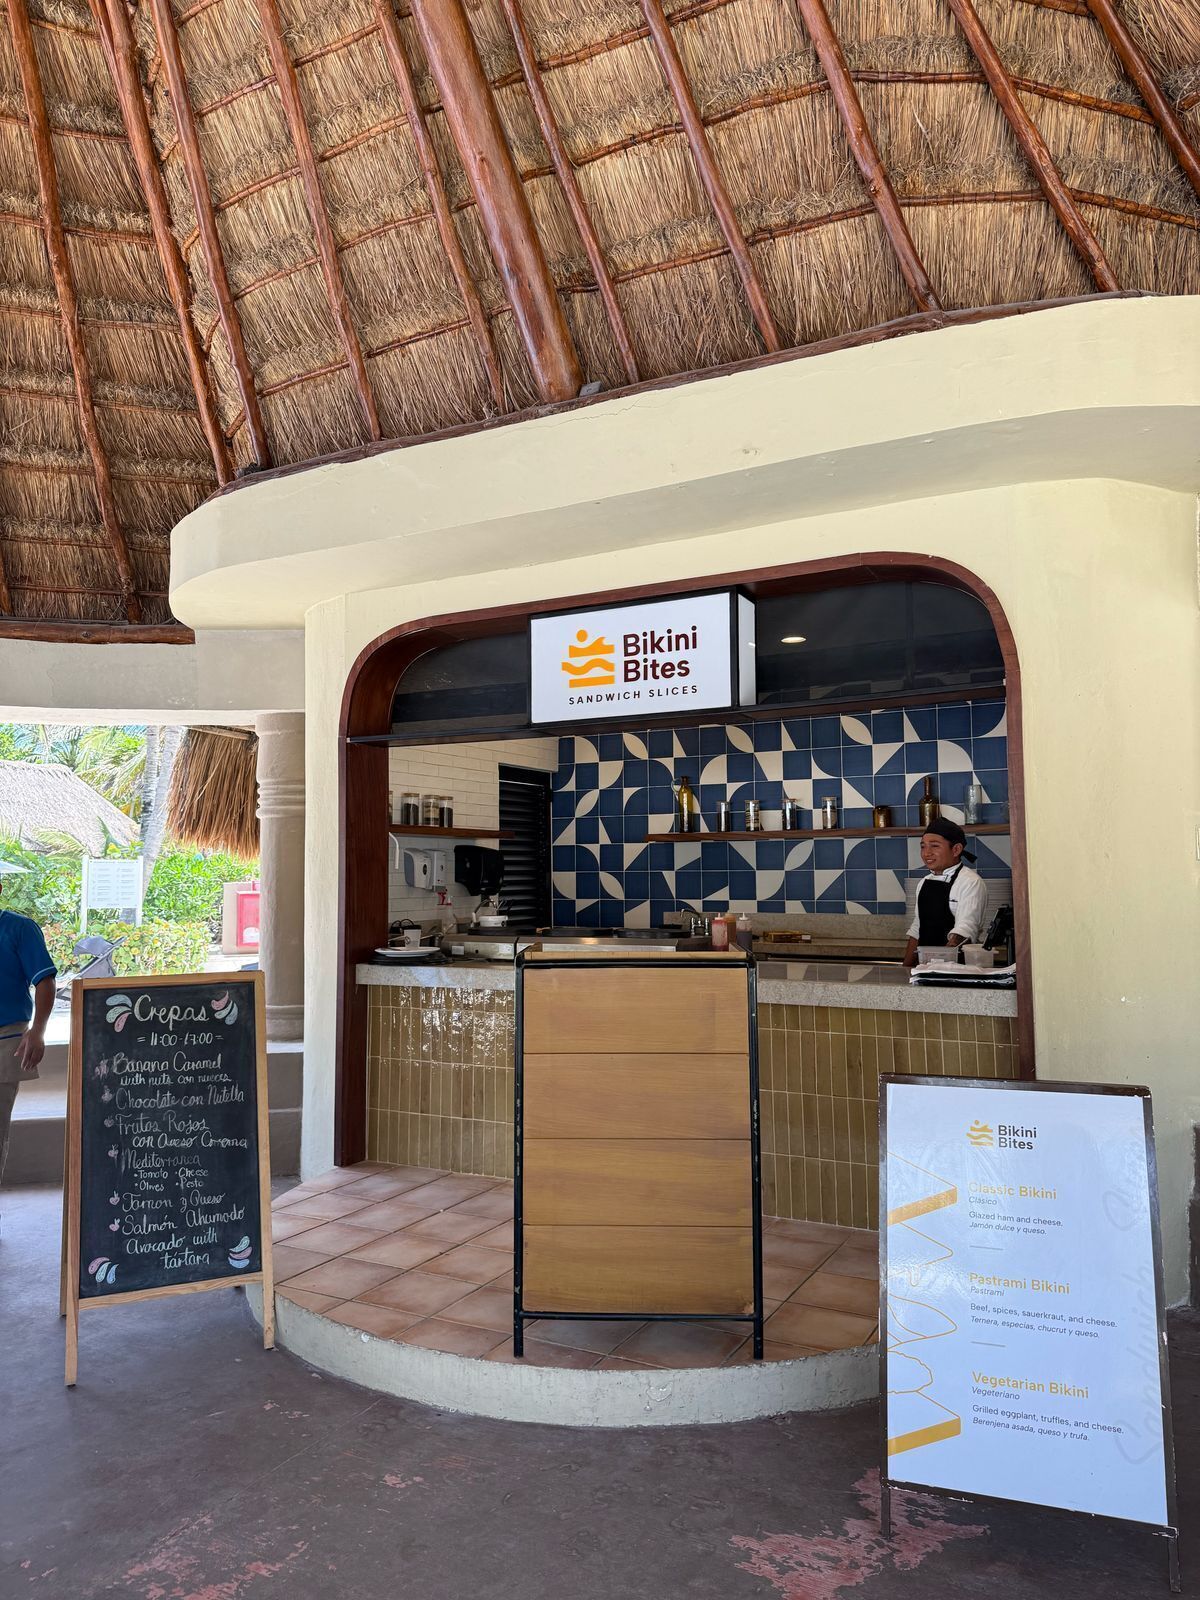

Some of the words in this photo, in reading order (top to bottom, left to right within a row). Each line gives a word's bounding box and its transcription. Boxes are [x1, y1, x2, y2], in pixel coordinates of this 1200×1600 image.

[623, 625, 698, 657] Bikini
[623, 657, 690, 683] Bites
[568, 690, 641, 705] SANDWICH
[648, 685, 698, 698] SLICES
[134, 994, 209, 1031] Crepas
[113, 1051, 169, 1075] Banana
[173, 1051, 222, 1072] Caramel
[120, 1073, 146, 1086] with
[149, 1073, 174, 1087] nuts
[177, 1074, 195, 1084] con
[115, 1087, 179, 1110] Chocolate
[181, 1094, 204, 1107] con
[207, 1084, 245, 1105] Nutella
[115, 1113, 162, 1136] Frutos
[163, 1109, 210, 1134] Rojos
[998, 1124, 1037, 1139] Bikini
[132, 1135, 154, 1149] con
[998, 1137, 1034, 1150] Bites
[138, 1169, 169, 1179] Tomato
[178, 1167, 209, 1178] Cheese
[180, 1177, 204, 1190] Pesto
[190, 1189, 226, 1207] Queso
[968, 1182, 1015, 1196] Classic
[1019, 1185, 1057, 1200] Bikini
[122, 1215, 178, 1236] Salmón
[185, 1203, 246, 1228] Ahumado
[968, 1211, 996, 1220] Glazed
[998, 1214, 1015, 1222] ham
[1016, 1216, 1031, 1224] and
[1032, 1217, 1063, 1227] cheese.
[995, 1223, 1015, 1232] dulce
[1022, 1227, 1047, 1235] queso.
[126, 1235, 186, 1255] Avocado
[193, 1227, 218, 1245] with
[969, 1272, 1027, 1290] Pastrami
[1031, 1279, 1070, 1294] Bikini
[970, 1286, 1005, 1297] Pastrami
[970, 1303, 991, 1313] Beef,
[992, 1306, 1020, 1317] spices,
[1022, 1309, 1066, 1322] sauerkraut,
[1068, 1315, 1084, 1324] and
[1085, 1316, 1118, 1328] cheese.
[971, 1316, 1000, 1327] Ternera,
[1001, 1320, 1036, 1331] especias,
[1037, 1324, 1067, 1334] chucrut
[1075, 1329, 1100, 1338] queso.
[972, 1371, 1045, 1393] Vegetarian
[1049, 1382, 1089, 1399] Bikini
[972, 1404, 999, 1416] Grilled
[1000, 1409, 1039, 1422] eggplant,
[1041, 1414, 1072, 1427] truffles,
[1074, 1420, 1090, 1429] and
[1091, 1421, 1125, 1434] cheese.
[972, 1416, 1010, 1429] Berenjena
[1011, 1423, 1036, 1434] asada,
[1037, 1427, 1061, 1437] queso
[1063, 1431, 1068, 1439] y
[1069, 1431, 1090, 1441] trufa.
